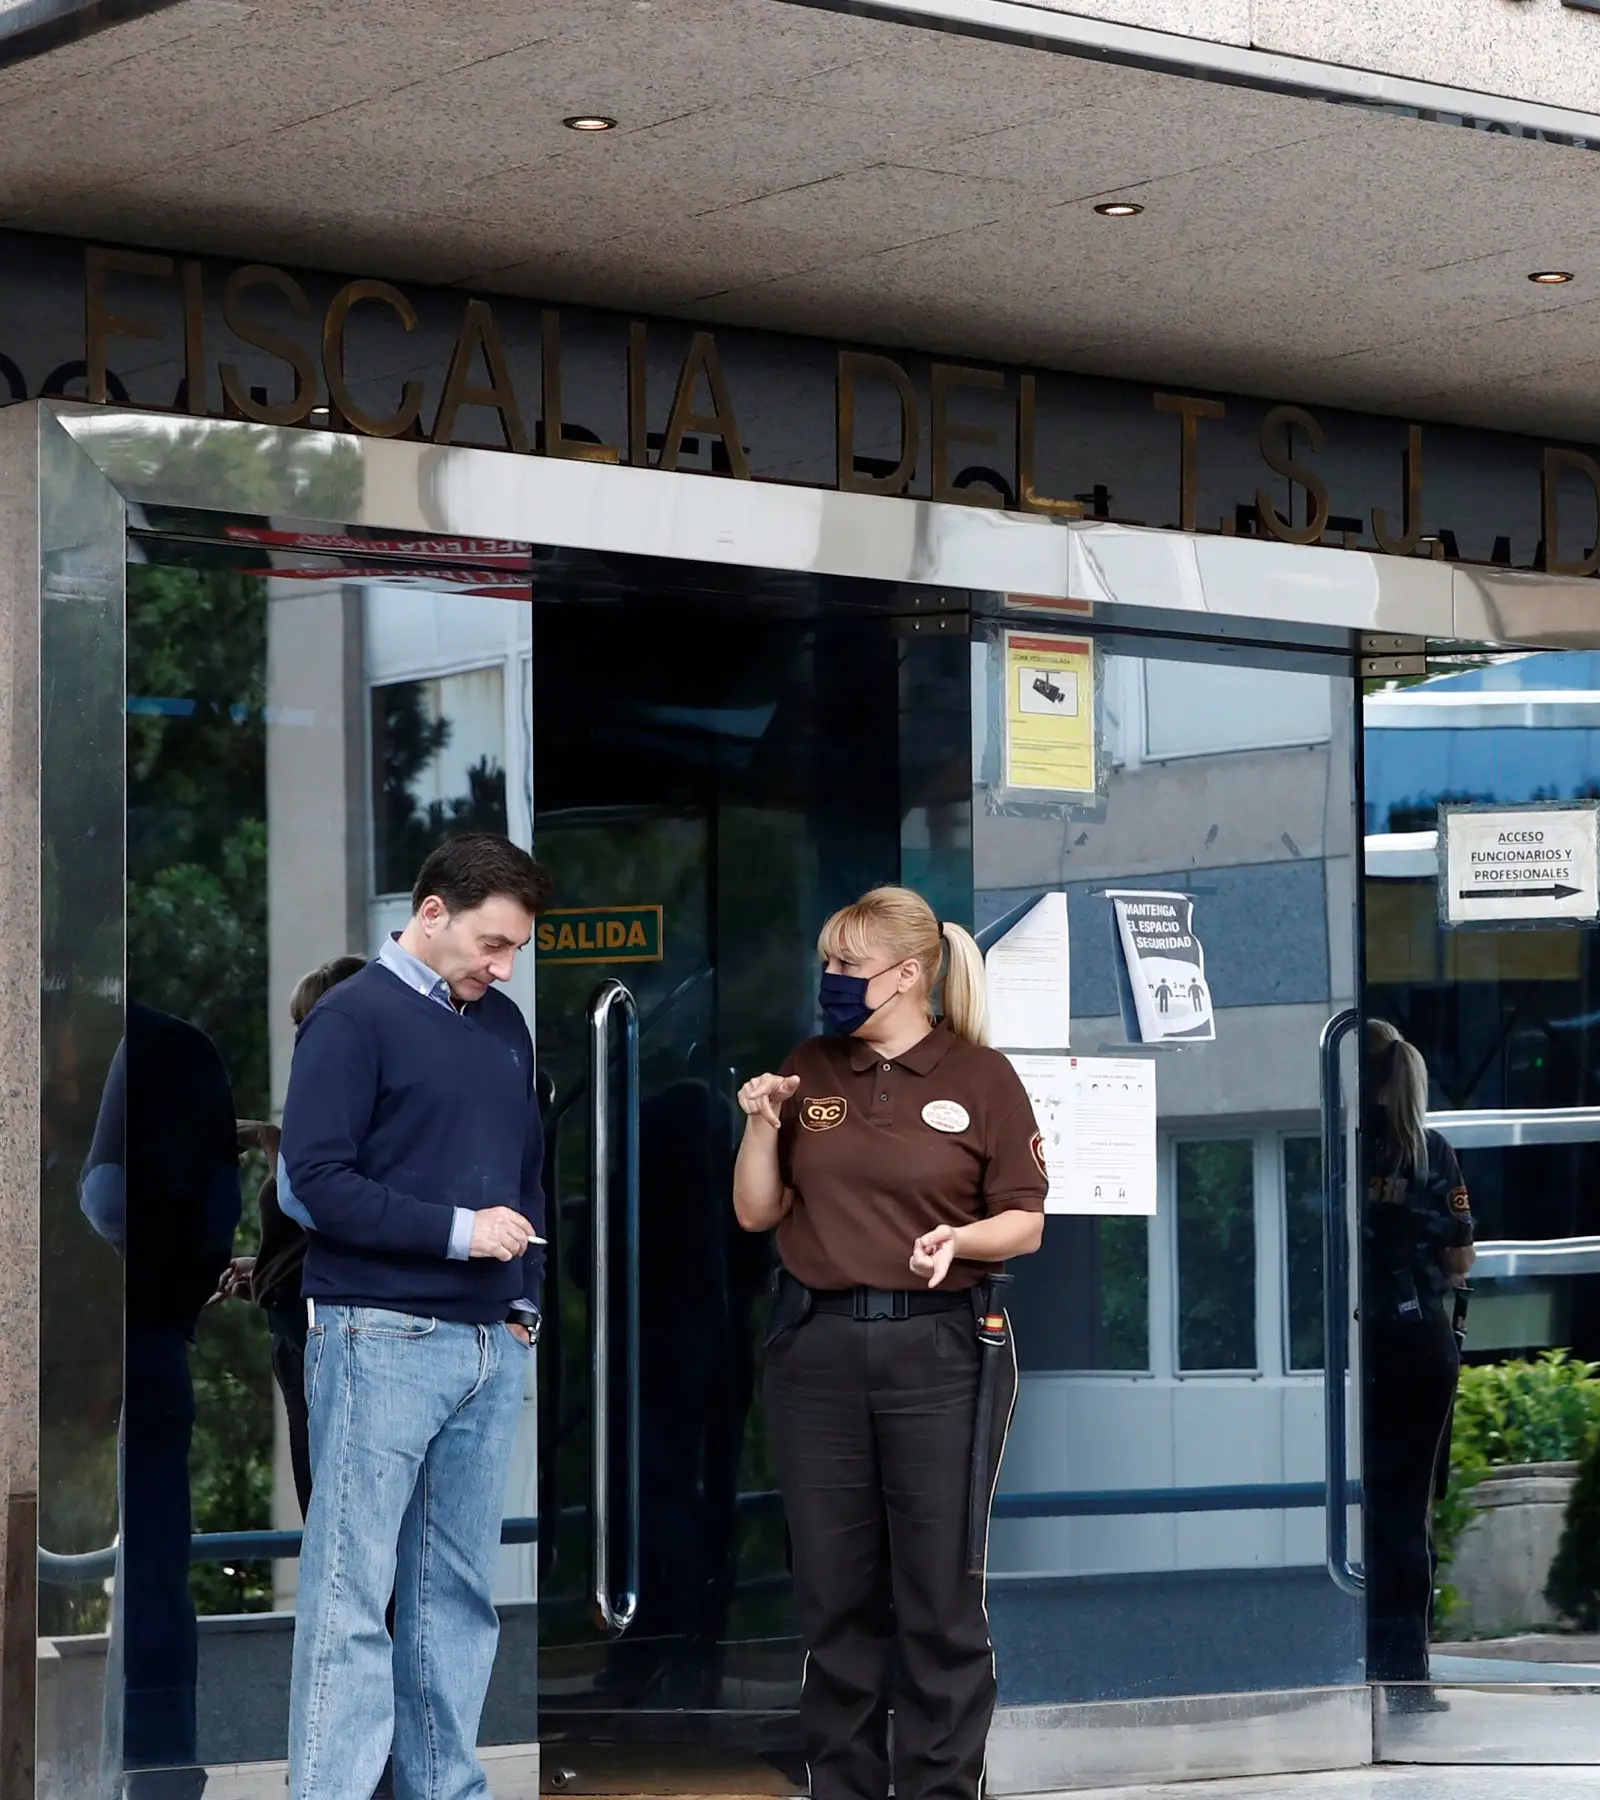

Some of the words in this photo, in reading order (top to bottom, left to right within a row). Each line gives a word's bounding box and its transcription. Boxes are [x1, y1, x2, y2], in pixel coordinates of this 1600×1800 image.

[84, 247, 751, 480] FISCALIA
[836, 350, 1084, 518] DEL
[1498, 831, 1544, 843] ACCESO
[1471, 849, 1561, 863] FUNCIONARIOS
[1562, 849, 1572, 859] Y
[1474, 868, 1569, 881] PROFESIONALES
[1124, 903, 1177, 917] MANTENGA
[1127, 920, 1139, 932] EL
[1139, 920, 1180, 933] ESPACIO
[537, 920, 647, 950] SALIDA
[1136, 936, 1192, 949] SEGURIDAD
